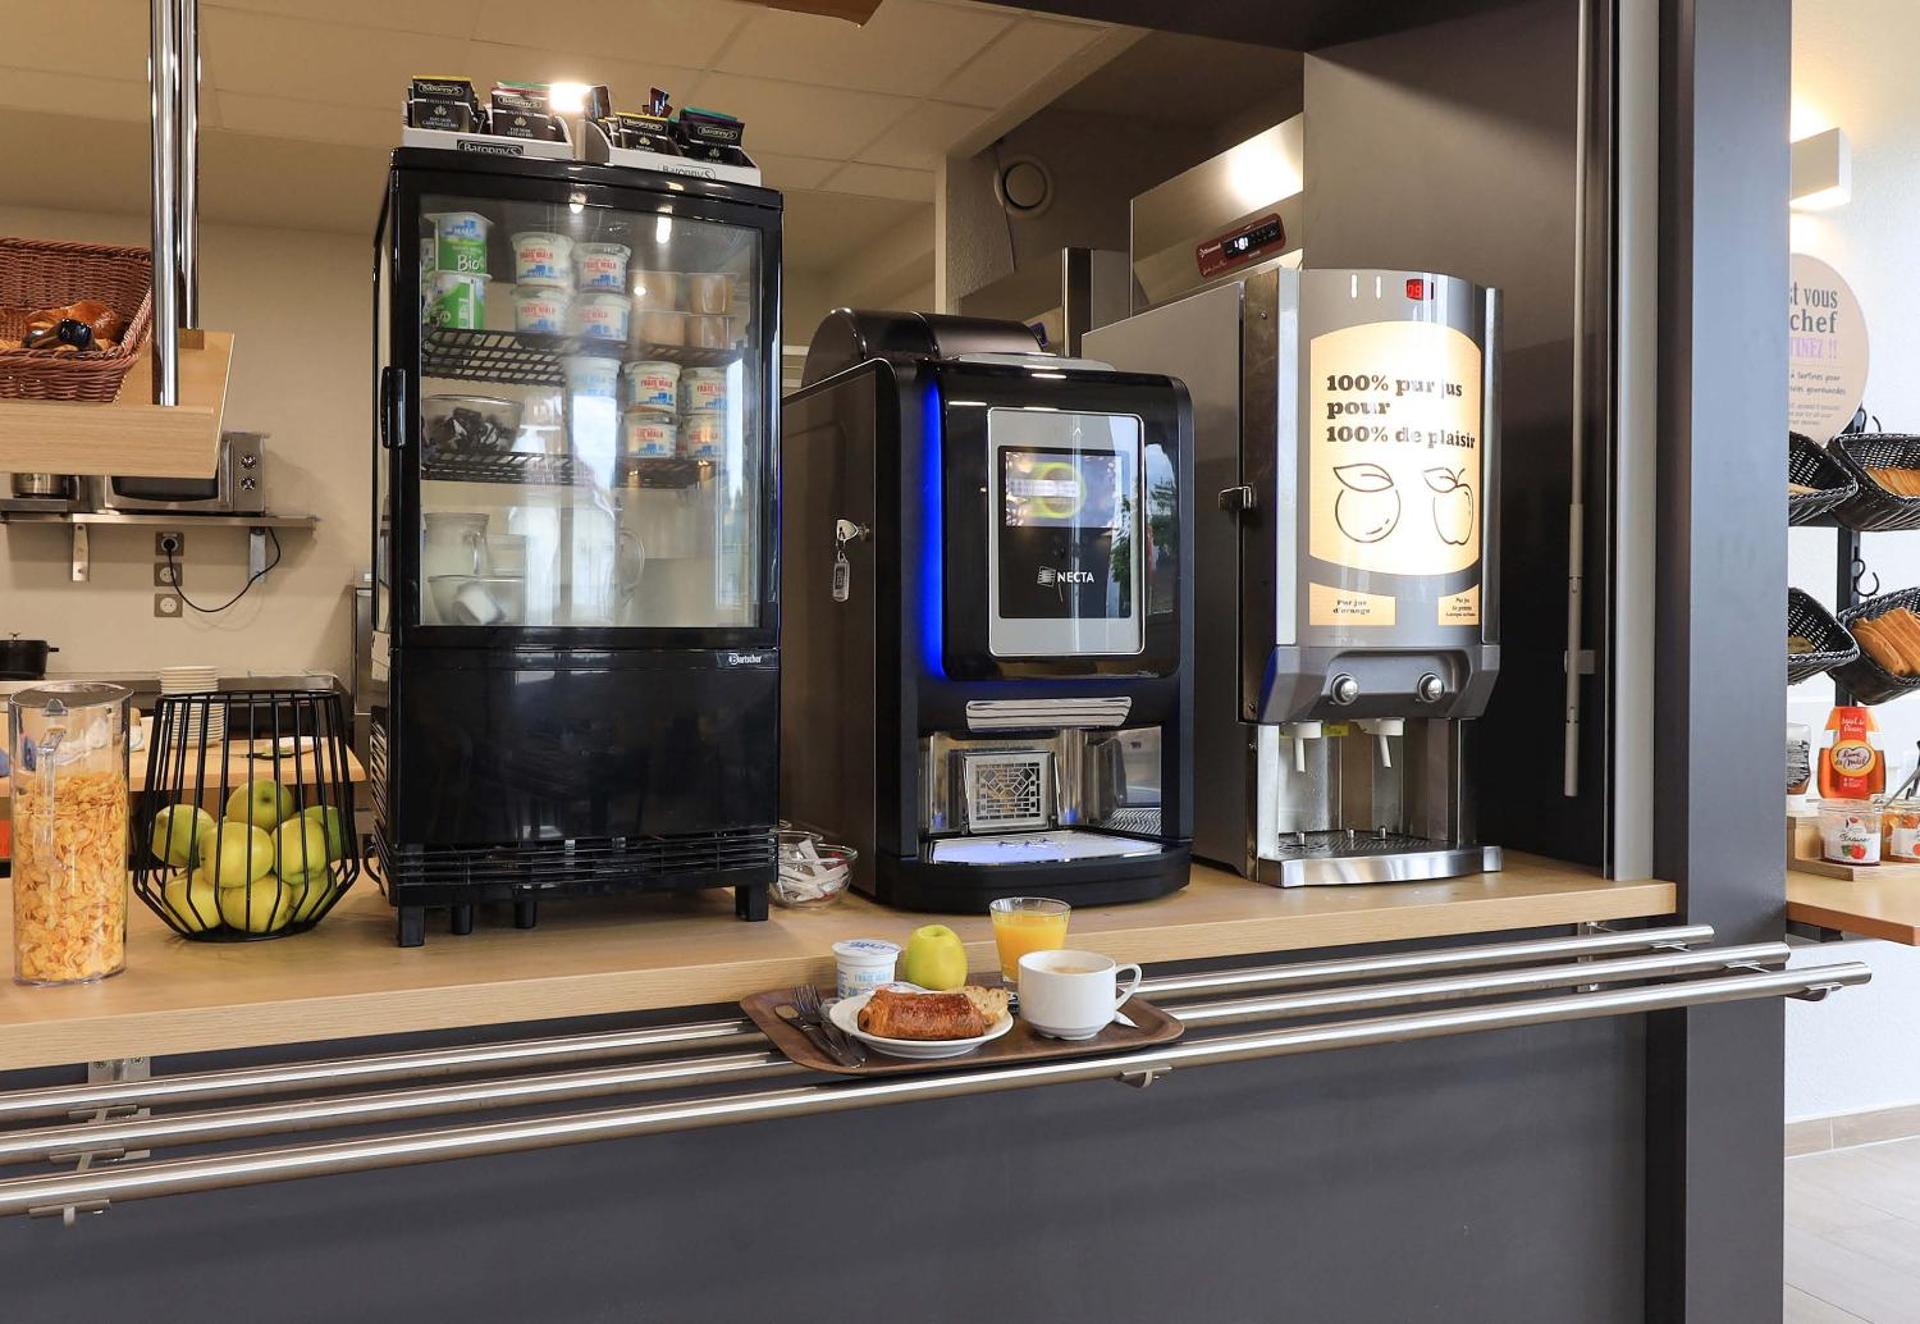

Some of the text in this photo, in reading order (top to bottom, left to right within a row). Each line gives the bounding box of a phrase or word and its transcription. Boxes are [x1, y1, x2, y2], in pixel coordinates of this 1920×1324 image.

[457, 254, 480, 271] Bio
[1804, 287, 1838, 309] vous
[1790, 309, 1838, 334] chef
[1327, 374, 1463, 399] 100% pur jus
[1327, 401, 1390, 419] pour
[1326, 426, 1476, 449] 100% de plaisir
[1057, 572, 1095, 583] NECTA
